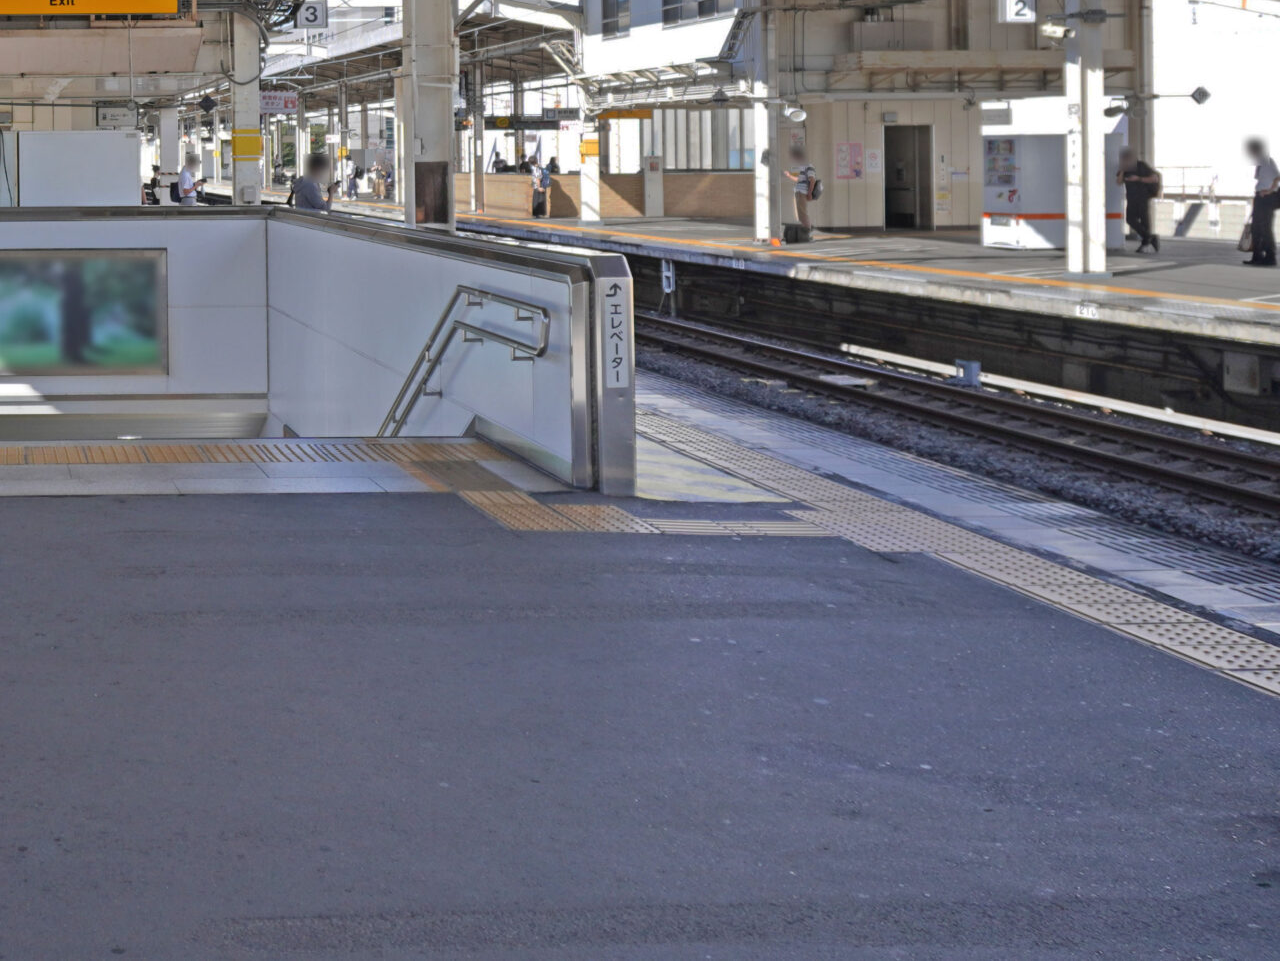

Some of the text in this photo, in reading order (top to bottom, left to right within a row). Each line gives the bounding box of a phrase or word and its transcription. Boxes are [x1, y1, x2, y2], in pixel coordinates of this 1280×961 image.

[305, 5, 318, 23] 3
[1014, 0, 1027, 17] 2
[610, 304, 623, 382] エレベーター
